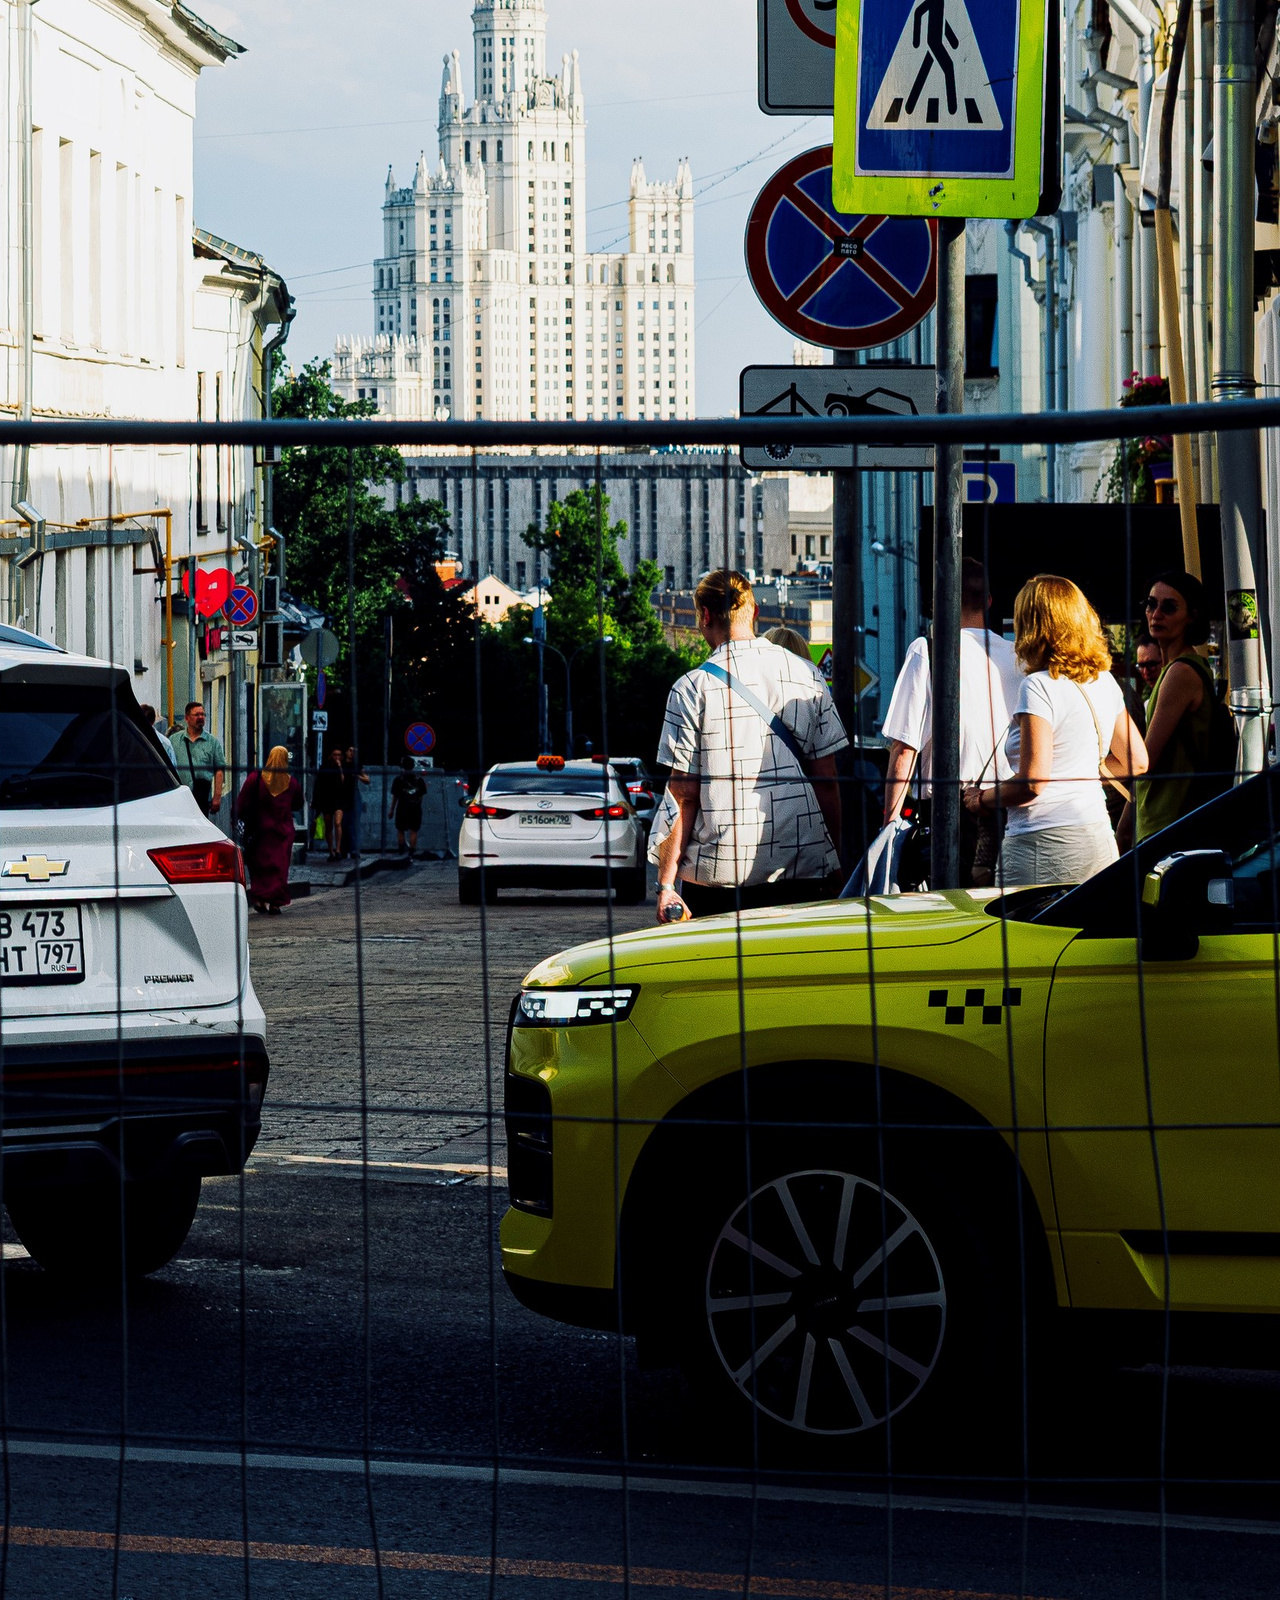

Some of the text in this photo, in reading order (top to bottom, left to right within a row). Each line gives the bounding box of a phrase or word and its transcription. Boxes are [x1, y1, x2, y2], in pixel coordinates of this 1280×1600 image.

[22, 911, 65, 938] 473
[40, 944, 74, 964] 797
[144, 973, 195, 984] PREMIER
